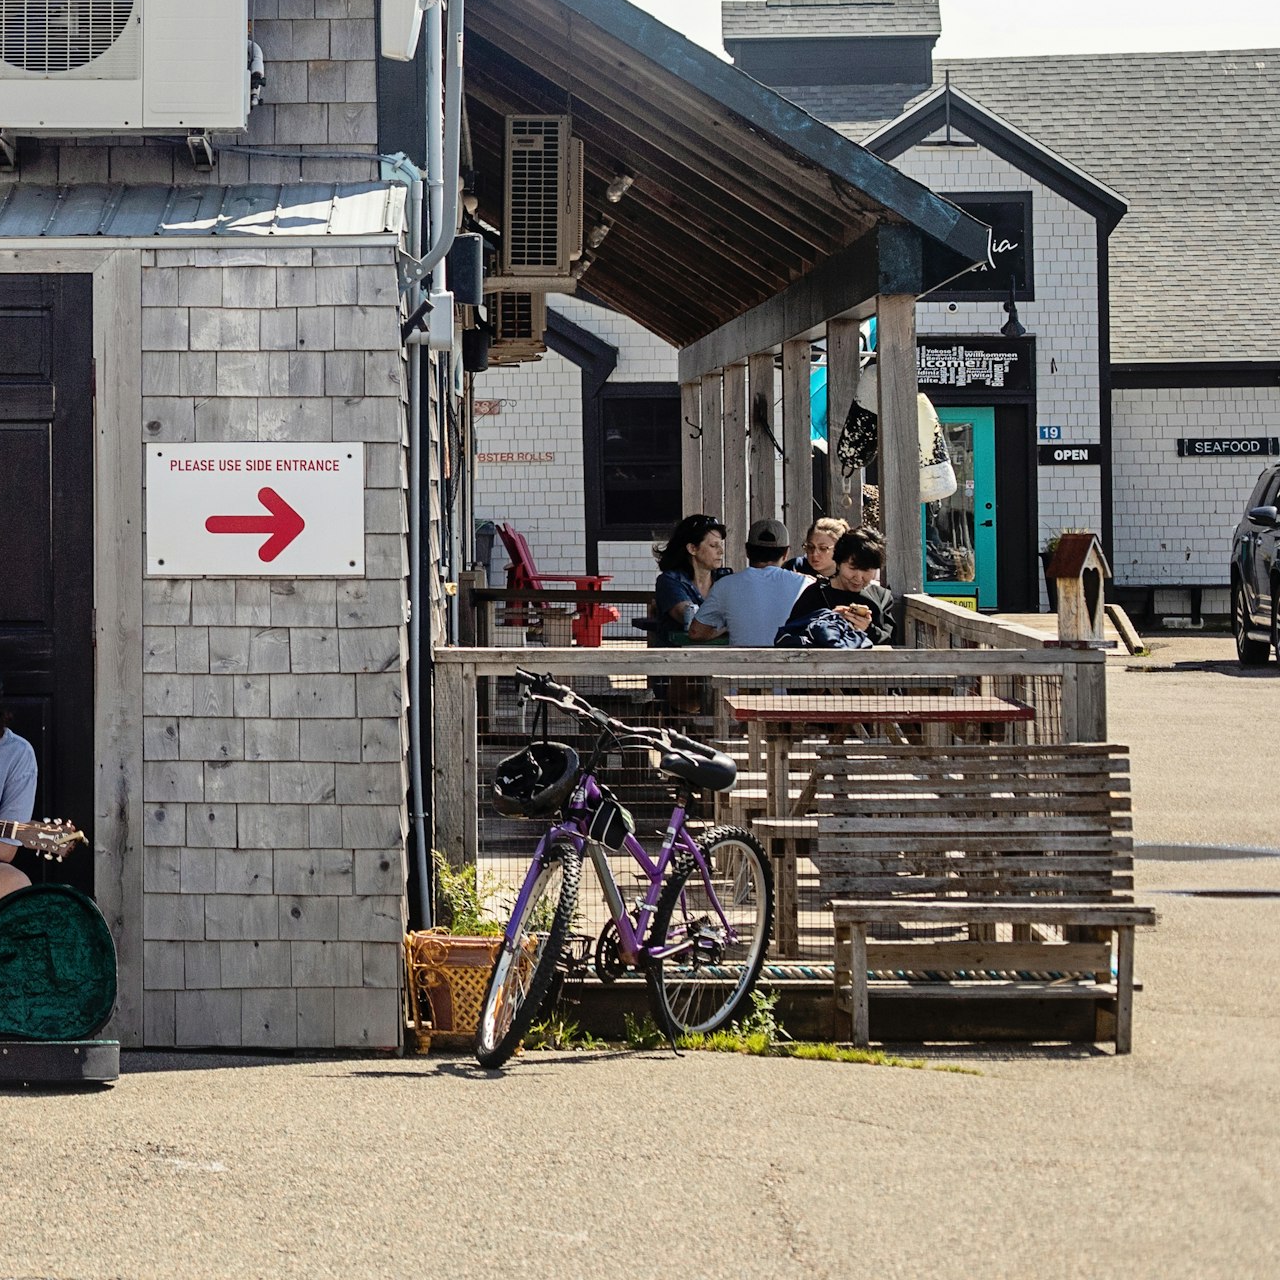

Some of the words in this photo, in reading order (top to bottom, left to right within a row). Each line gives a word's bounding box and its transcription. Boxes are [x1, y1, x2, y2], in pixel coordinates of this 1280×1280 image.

[917, 359, 976, 368] lcome
[1042, 428, 1058, 439] 19
[1194, 440, 1260, 453] SEAFOOD
[477, 452, 514, 462] BSTER
[518, 451, 553, 461] ROLLS
[1054, 449, 1088, 461] OPEN
[170, 460, 215, 471] PLEASE
[219, 460, 241, 471] USE
[245, 460, 272, 471] SIDE
[276, 460, 340, 471] ENTRANCE
